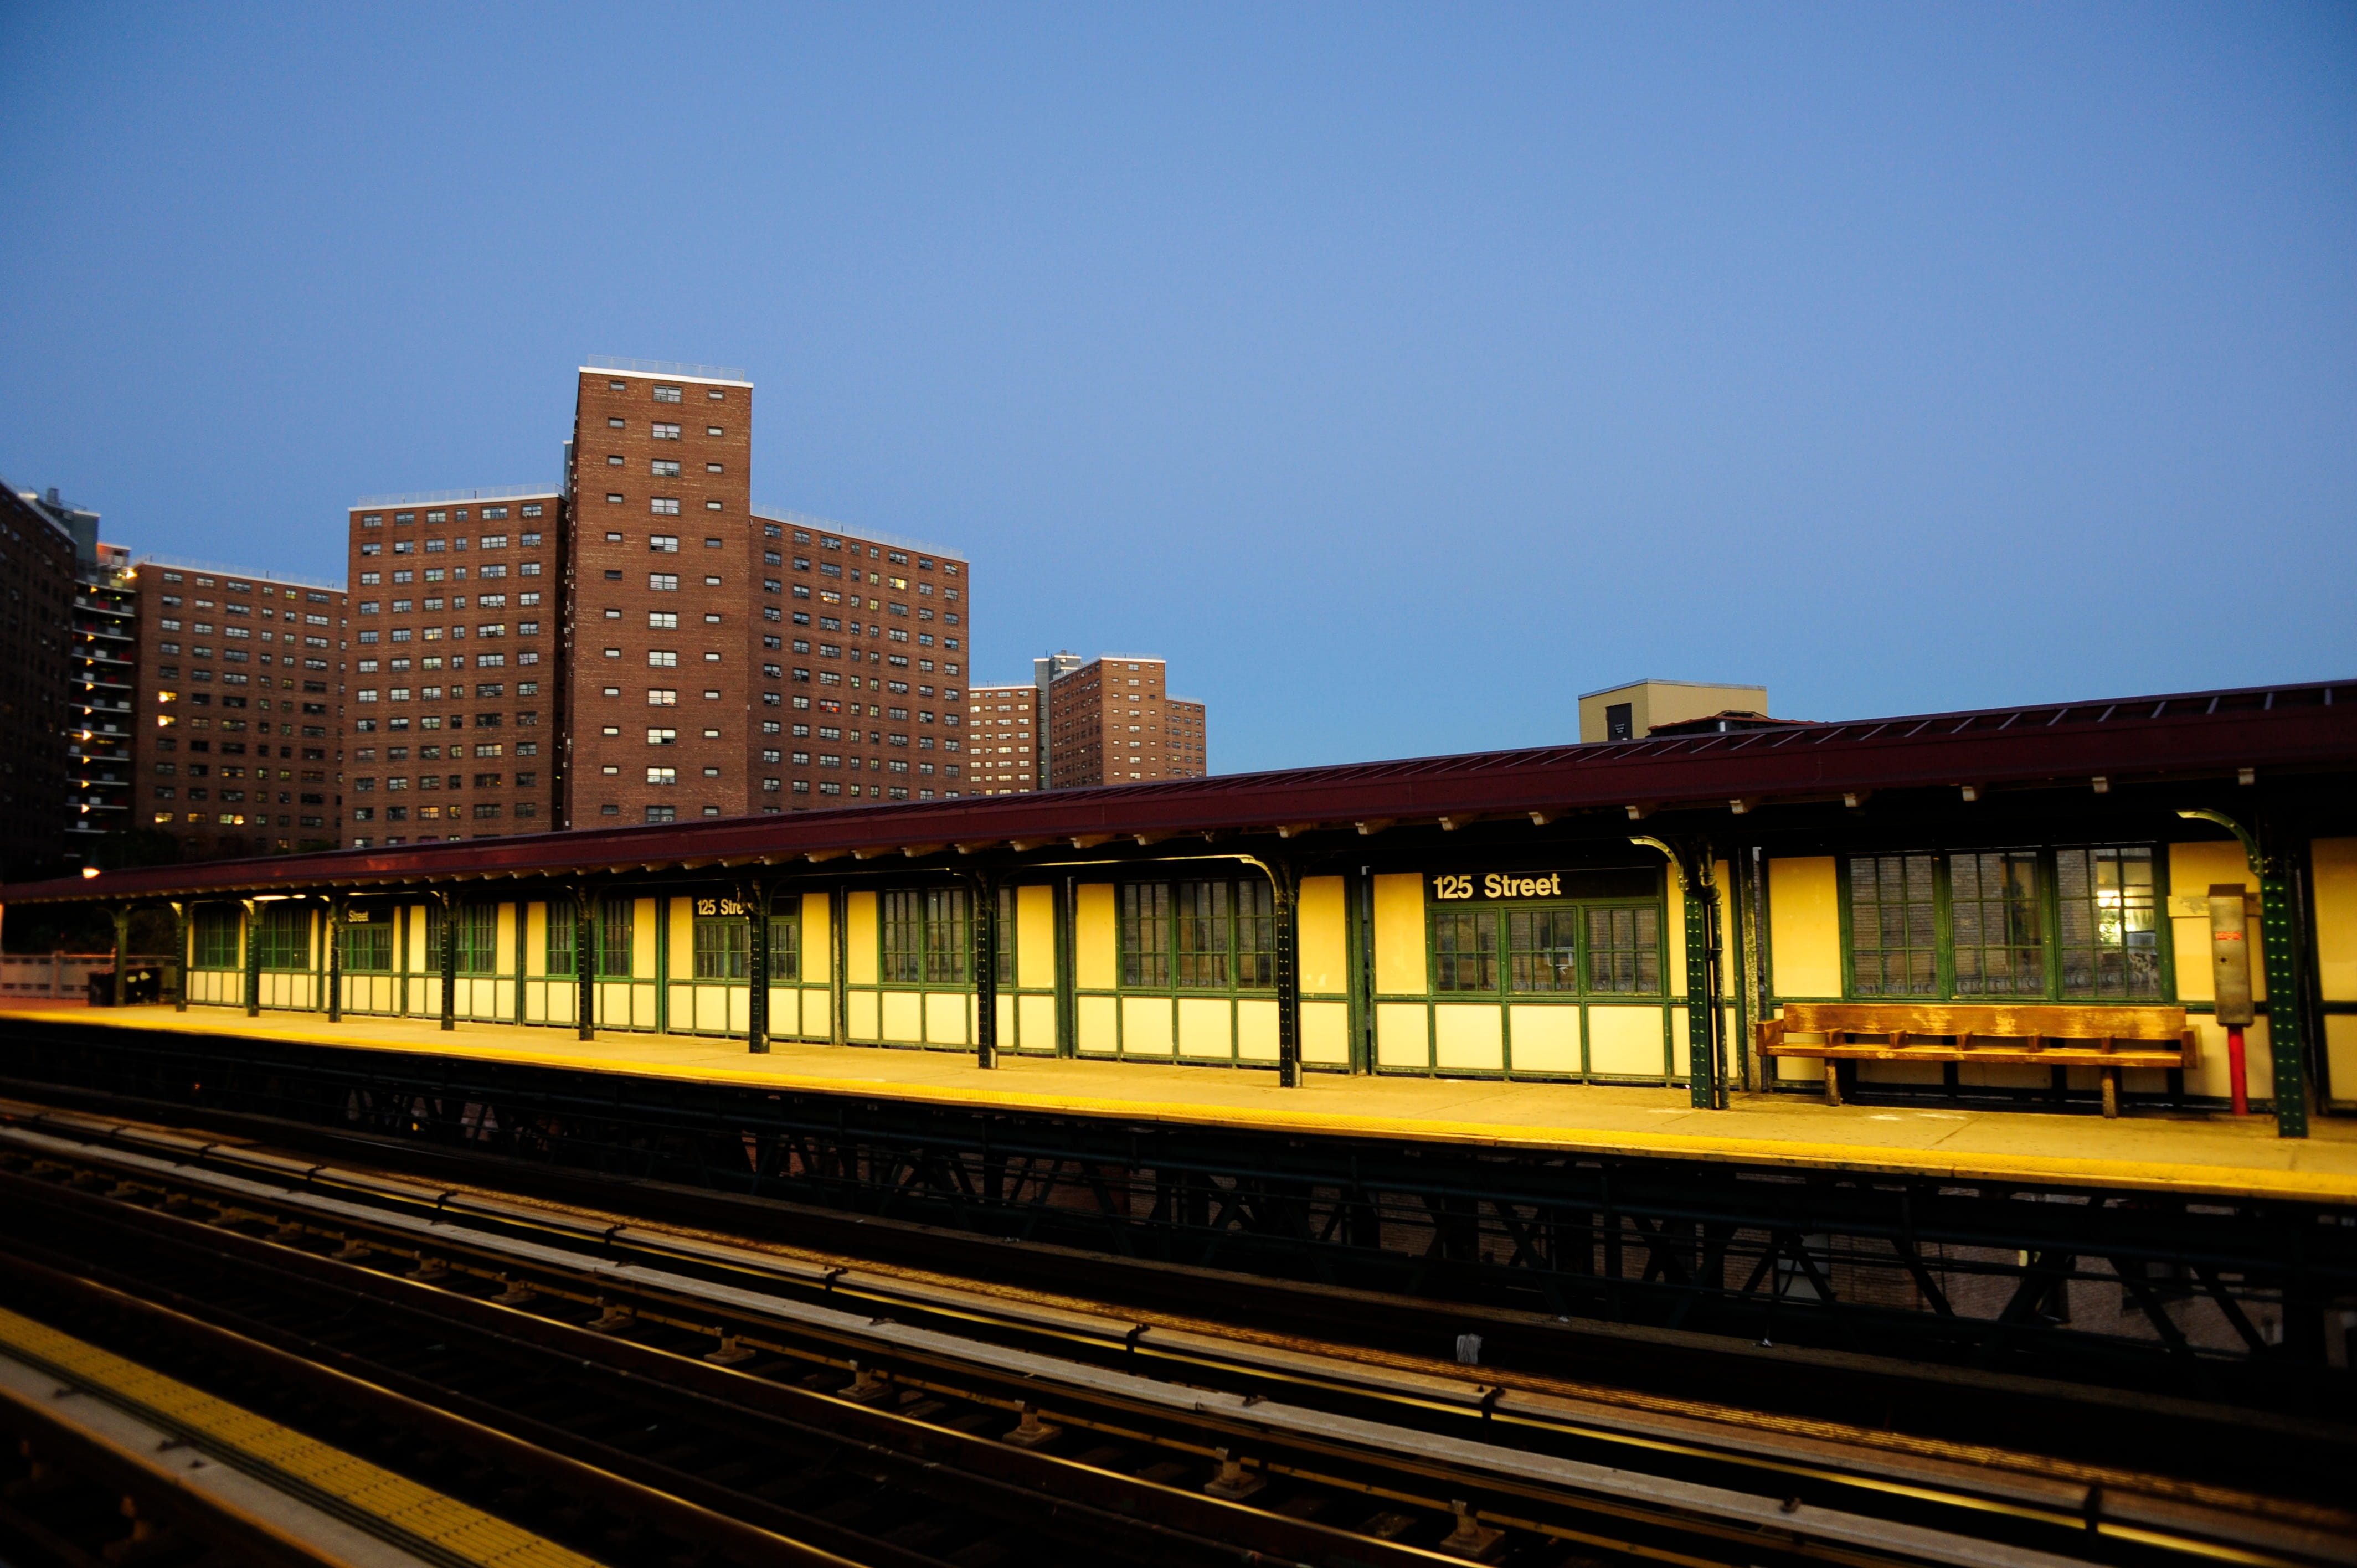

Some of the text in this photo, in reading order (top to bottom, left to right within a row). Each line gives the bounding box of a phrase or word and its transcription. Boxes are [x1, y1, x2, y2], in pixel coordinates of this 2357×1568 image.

[1433, 873, 1561, 899] 125 Street
[697, 898, 753, 915] 125 Stre
[348, 910, 369, 922] Street
